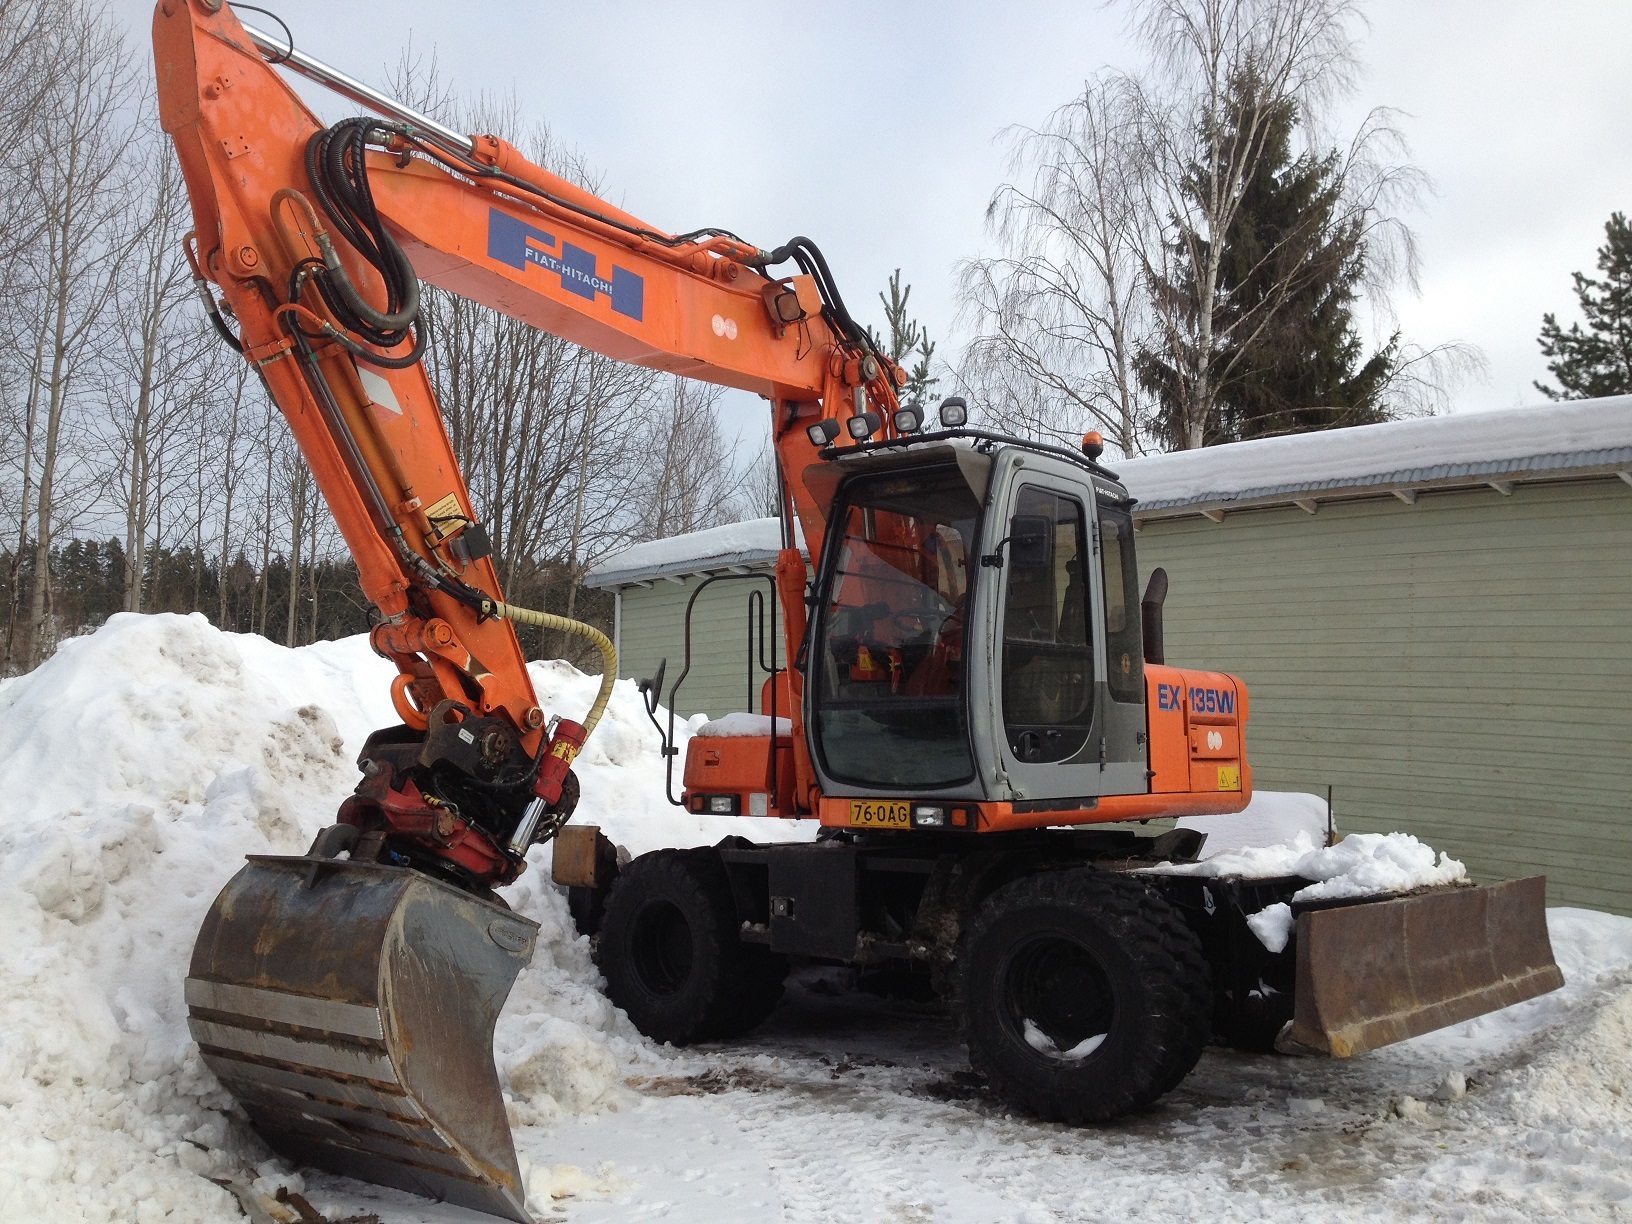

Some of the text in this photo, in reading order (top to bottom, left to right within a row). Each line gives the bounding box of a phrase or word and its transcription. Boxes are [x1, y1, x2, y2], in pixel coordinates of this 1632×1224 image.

[525, 247, 613, 295] FIAT-HITACHI
[1158, 683, 1235, 715] EX 135W
